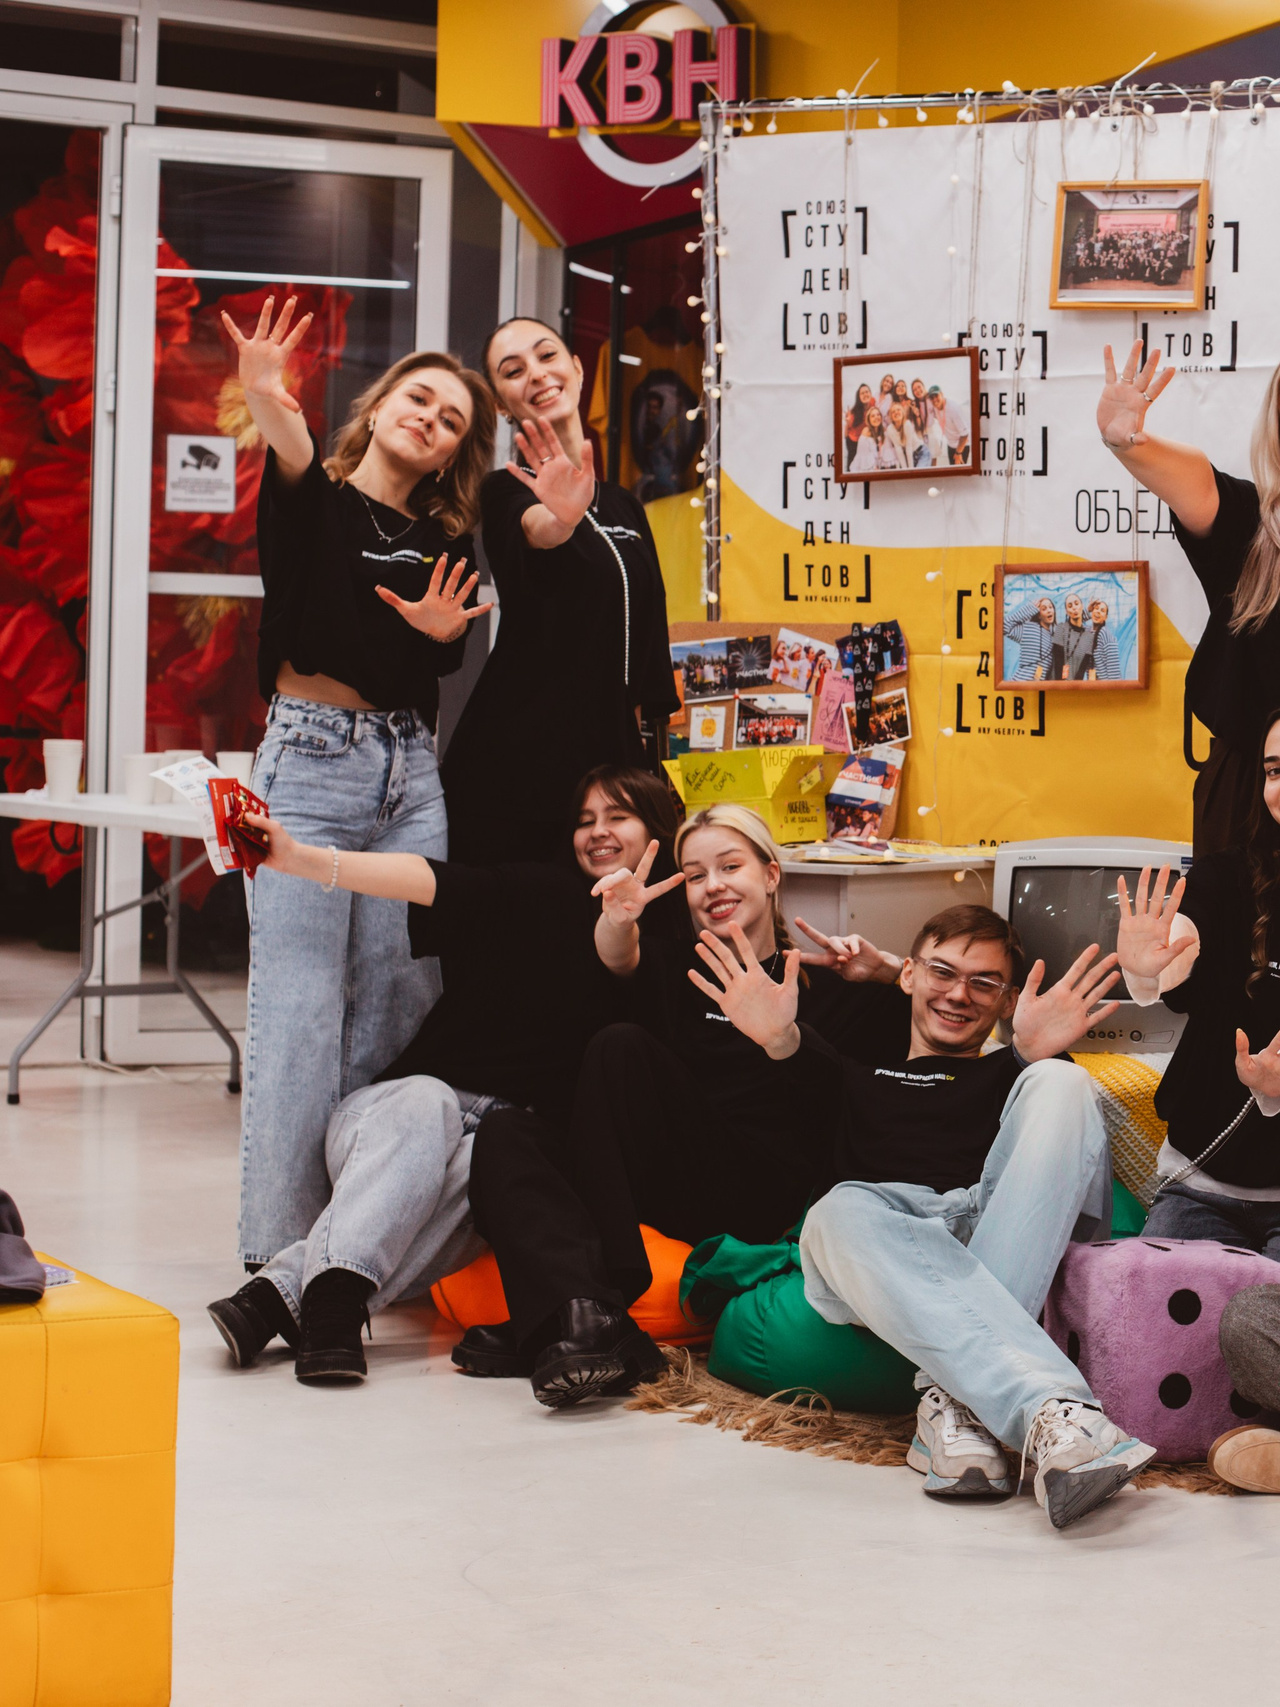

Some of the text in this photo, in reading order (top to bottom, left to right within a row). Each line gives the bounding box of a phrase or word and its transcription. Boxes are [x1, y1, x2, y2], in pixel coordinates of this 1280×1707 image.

[540, 24, 738, 128] КВН
[806, 199, 846, 215] СОЮЗ
[805, 224, 848, 248] СТУ
[802, 268, 849, 295] ДЕН
[803, 312, 848, 336] ТОВ
[981, 323, 1025, 338] СОЮЗ
[1165, 333, 1214, 357] ТОВ
[979, 348, 1025, 371] СТУ
[979, 392, 1025, 419] ДЕН
[979, 438, 1025, 461] ТОВ
[804, 478, 848, 500] СТУ
[1076, 489, 1176, 540] ОБЪЕД
[803, 521, 850, 547] ДЕН
[804, 564, 850, 588] ТОВ
[978, 695, 1024, 720] ТОВ
